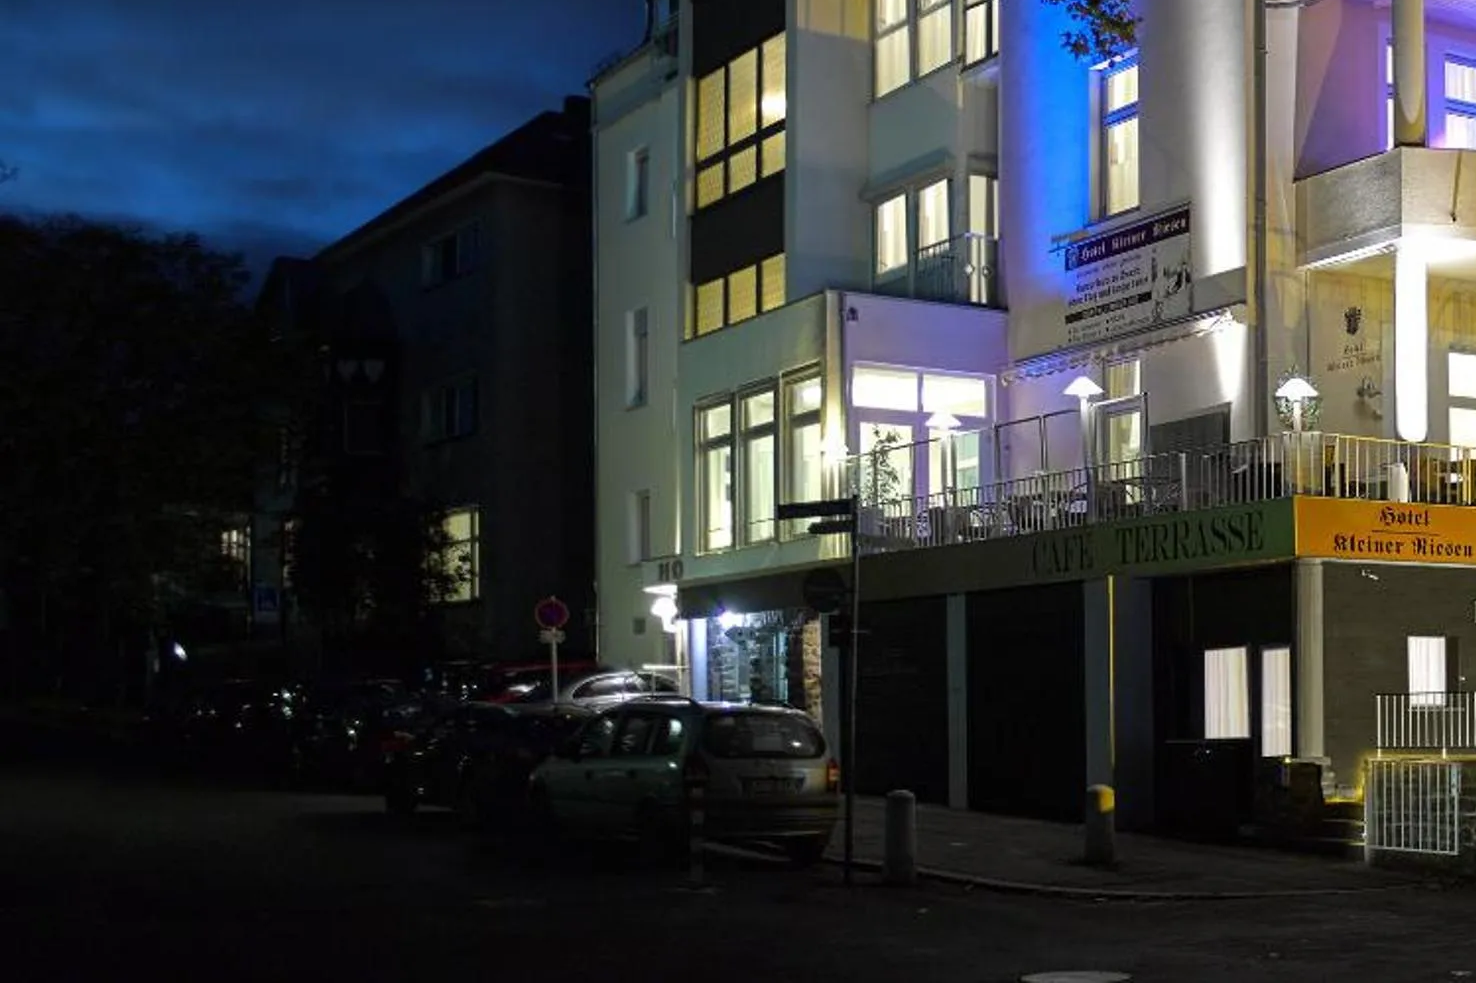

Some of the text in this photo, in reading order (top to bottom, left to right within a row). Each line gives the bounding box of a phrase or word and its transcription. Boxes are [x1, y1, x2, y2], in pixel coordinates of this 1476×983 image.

[1379, 506, 1430, 526] Hotel
[1115, 511, 1264, 565] TERRASSE
[1333, 533, 1474, 558] Kleiner Riesen
